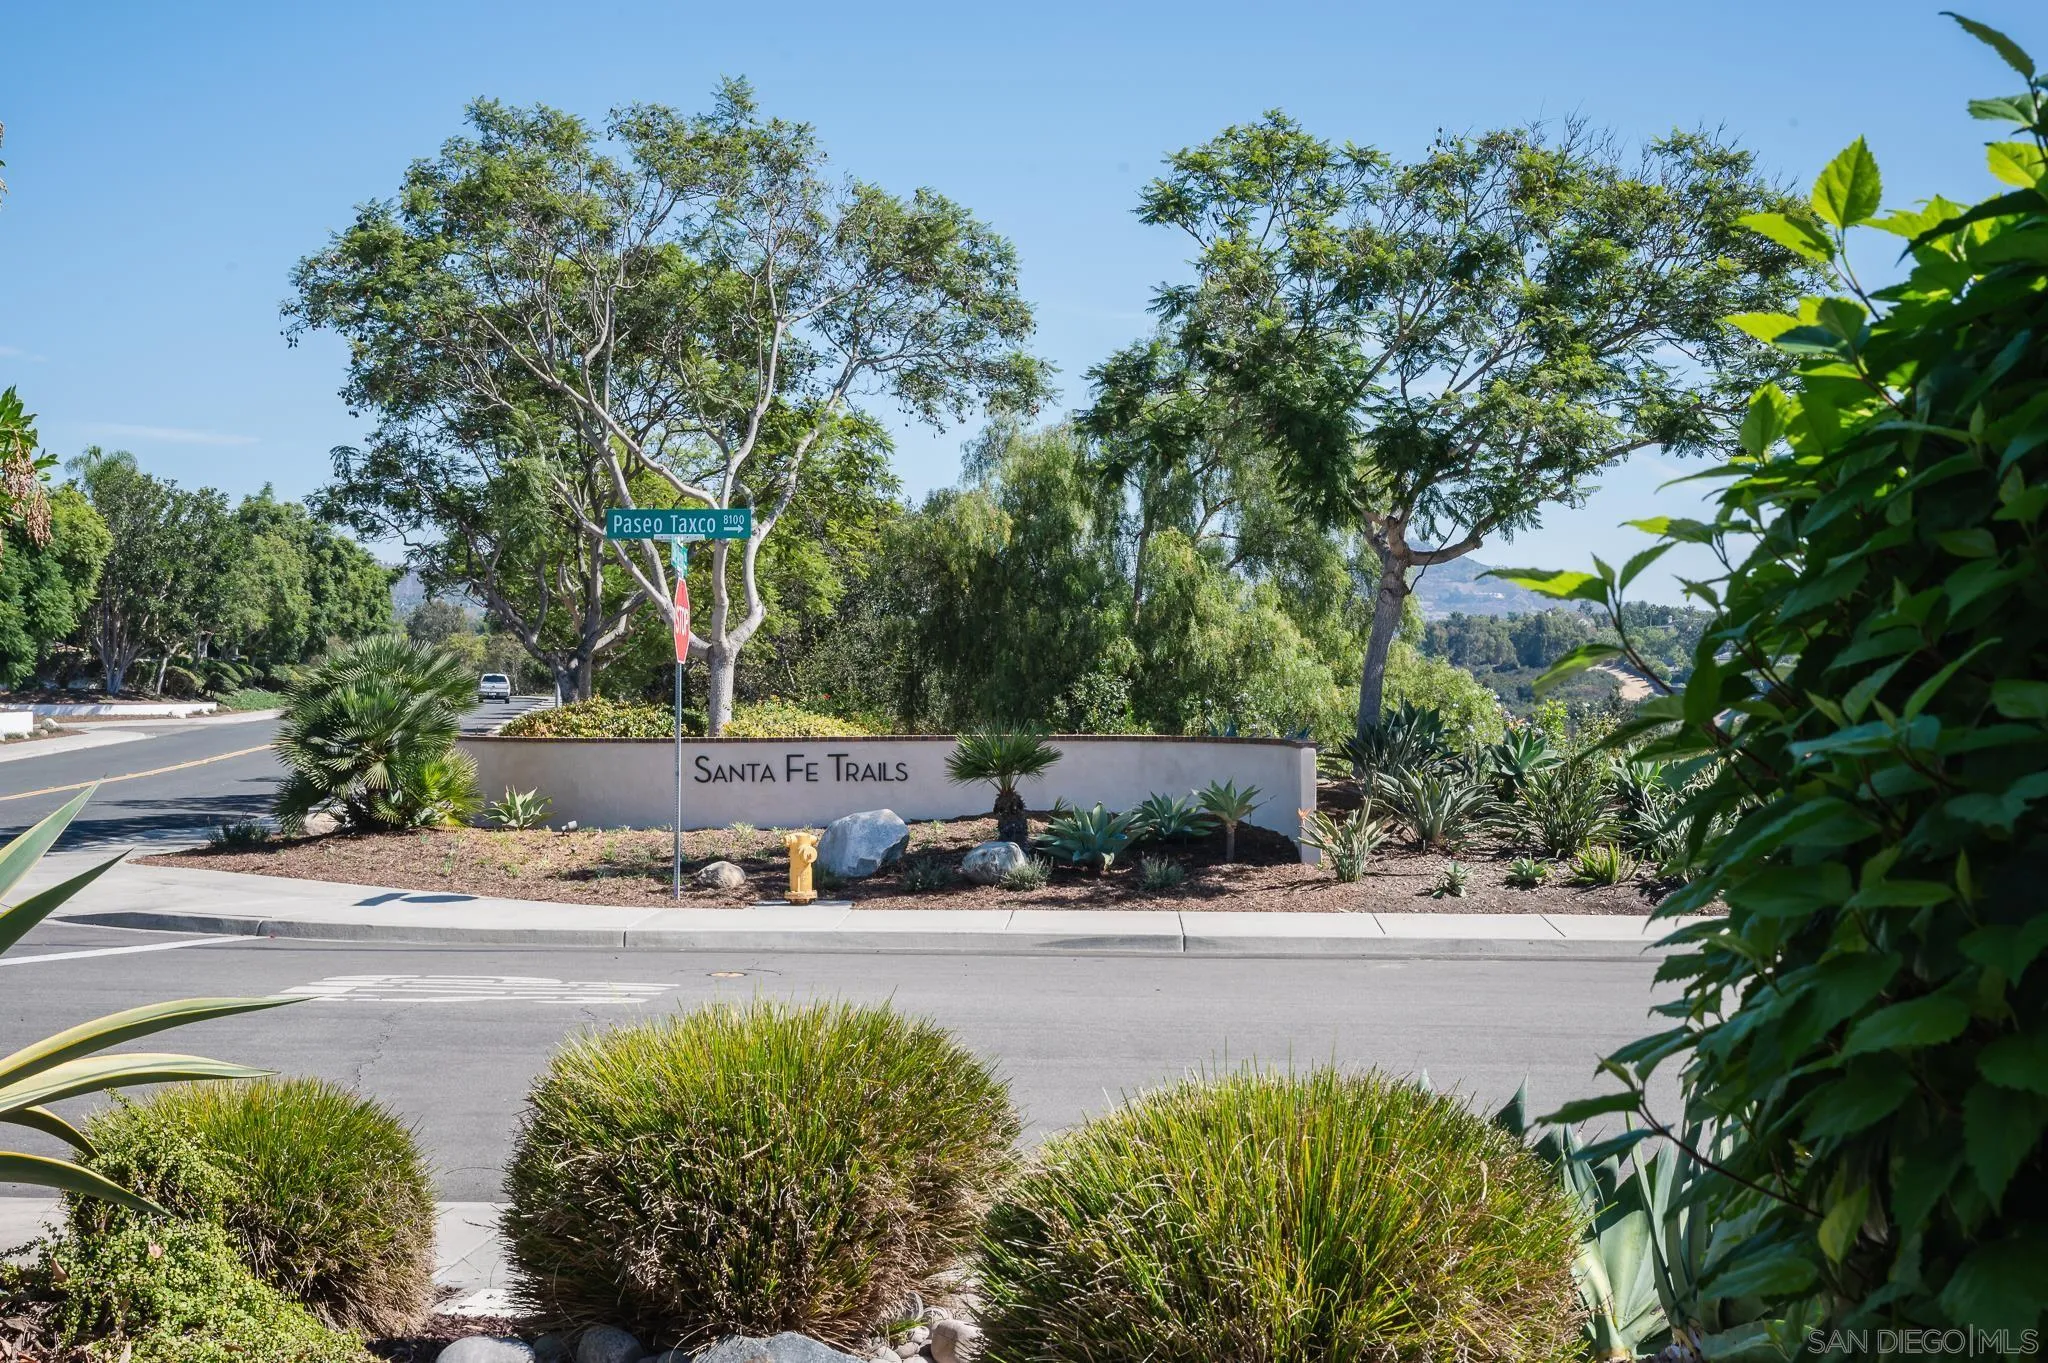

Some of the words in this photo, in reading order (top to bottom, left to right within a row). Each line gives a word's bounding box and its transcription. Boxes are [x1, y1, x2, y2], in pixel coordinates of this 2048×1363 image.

[613, 514, 663, 533] Paseo
[670, 514, 716, 533] Taxco
[723, 514, 745, 525] 8100
[675, 605, 689, 637] STOP
[694, 755, 776, 783] SANTA
[827, 753, 909, 782] TRAILS
